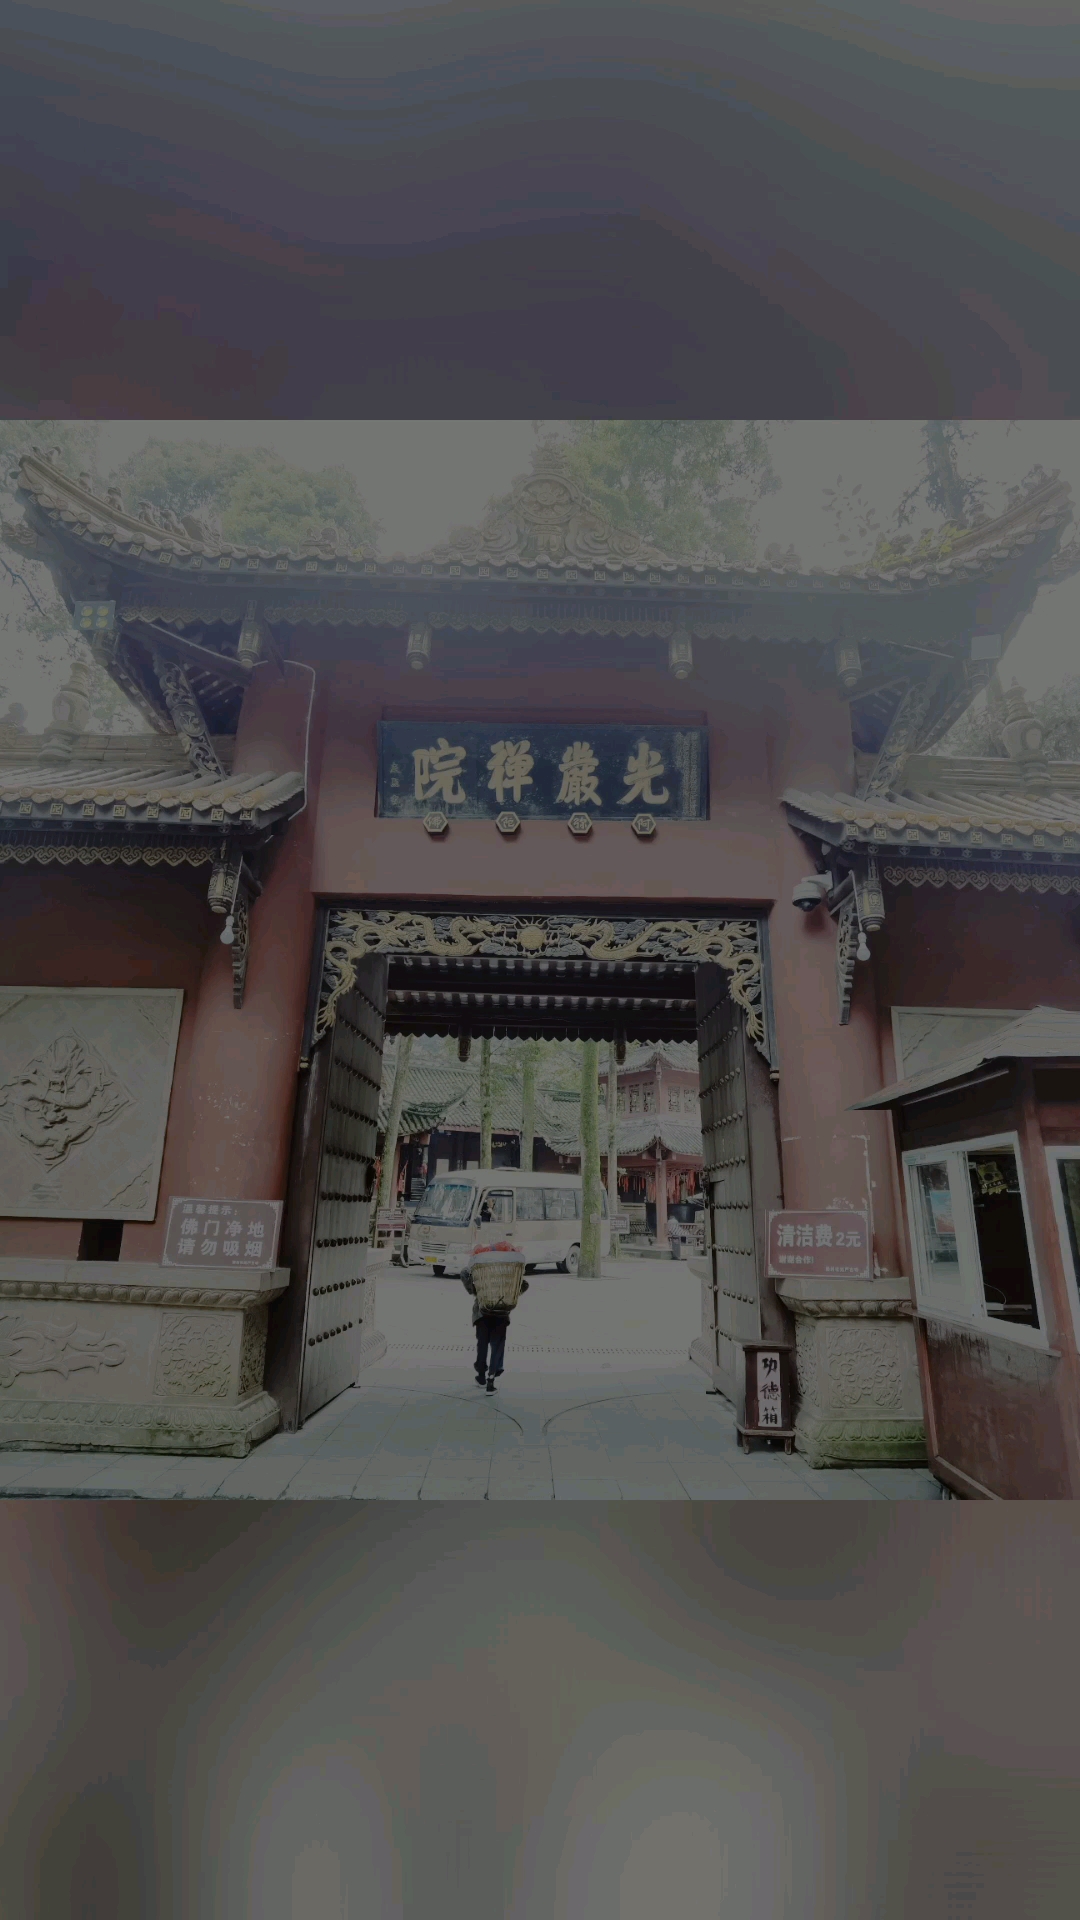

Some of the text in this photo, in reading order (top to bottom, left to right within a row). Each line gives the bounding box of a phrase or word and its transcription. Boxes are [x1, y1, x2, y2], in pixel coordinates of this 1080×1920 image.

[180, 1218, 265, 1238] 佛门净地
[777, 1224, 862, 1248] 清洁费2元
[177, 1237, 263, 1258] 请勿吸烟
[760, 1357, 780, 1425] 功德箱
